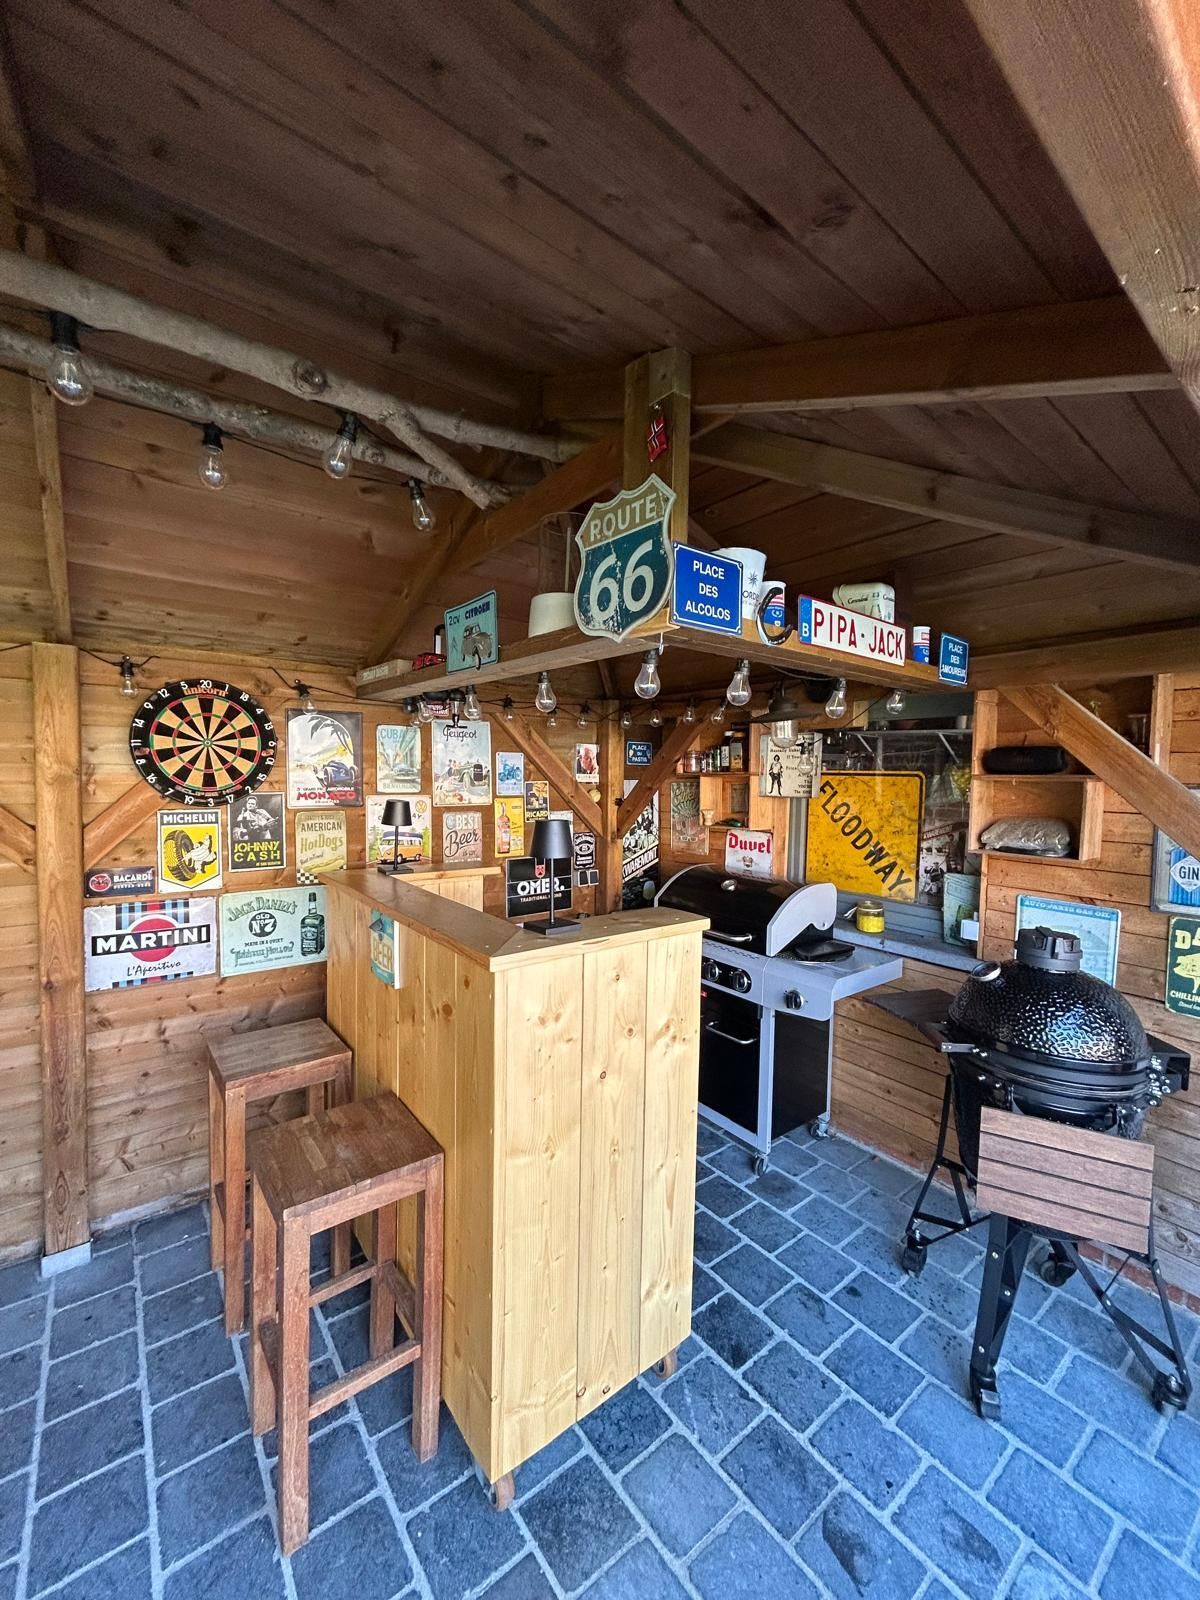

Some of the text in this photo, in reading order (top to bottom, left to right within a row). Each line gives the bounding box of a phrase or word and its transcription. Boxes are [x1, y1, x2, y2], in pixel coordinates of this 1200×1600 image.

[590, 492, 657, 542] ROUTE
[693, 560, 725, 580] PLACE
[589, 539, 654, 622] 66
[698, 582, 719, 598] DES
[685, 600, 731, 621] ALCOLOS
[801, 622, 810, 637] B
[948, 642, 963, 655] PLACE
[950, 654, 960, 664] DES
[180, 681, 189, 690] 5
[199, 679, 213, 689] 20
[224, 683, 230, 692] 1
[157, 688, 171, 699] 12
[183, 685, 228, 697] unicorn
[239, 691, 250, 702] 18
[143, 702, 154, 710] 9
[255, 707, 265, 715] 4
[132, 718, 145, 728] 14
[263, 721, 274, 731] 13
[380, 728, 405, 739] CUBA
[442, 726, 477, 743] Peugeot
[130, 739, 142, 747] 11
[265, 757, 275, 766] 10
[256, 772, 267, 782] 15
[340, 769, 346, 777] 2
[146, 774, 157, 784] 16
[164, 788, 175, 796] 7
[245, 785, 254, 794] 2
[183, 795, 195, 805] 19
[226, 794, 235, 804] 17
[296, 791, 356, 800] MONACO
[207, 798, 215, 807] 3
[163, 813, 216, 824] MICHELIN
[455, 813, 480, 830] BEST
[301, 821, 342, 833] AMERICAN
[820, 780, 912, 892] FLOODWAY
[234, 841, 280, 853] JOHNNY
[444, 829, 480, 858] Beer
[728, 832, 771, 854] Duvel
[234, 851, 280, 862] CASH
[1179, 865, 1200, 881] GIN
[1023, 900, 1046, 908] AUTO
[226, 900, 255, 922] JACK
[96, 926, 208, 954] MARTINI
[126, 961, 182, 977] L'Aperitivo
